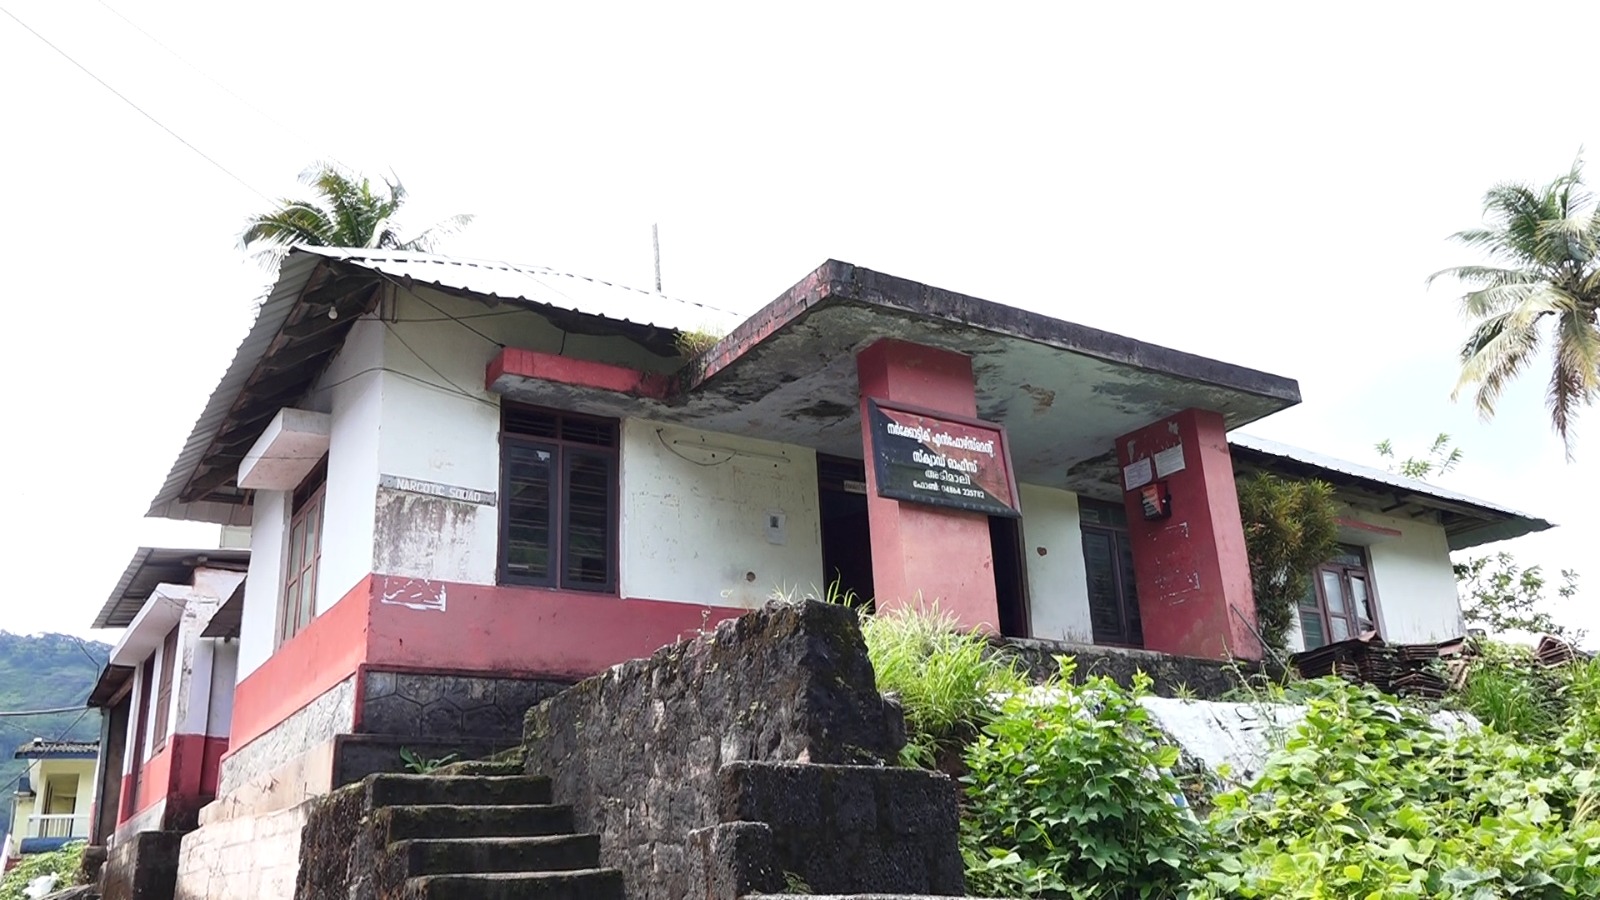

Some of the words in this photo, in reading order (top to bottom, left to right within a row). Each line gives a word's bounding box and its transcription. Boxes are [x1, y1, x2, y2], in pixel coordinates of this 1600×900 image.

[924, 469, 971, 486] അടിമാലി
[396, 478, 444, 496] NARCOTIC
[448, 488, 481, 502] SQUAD
